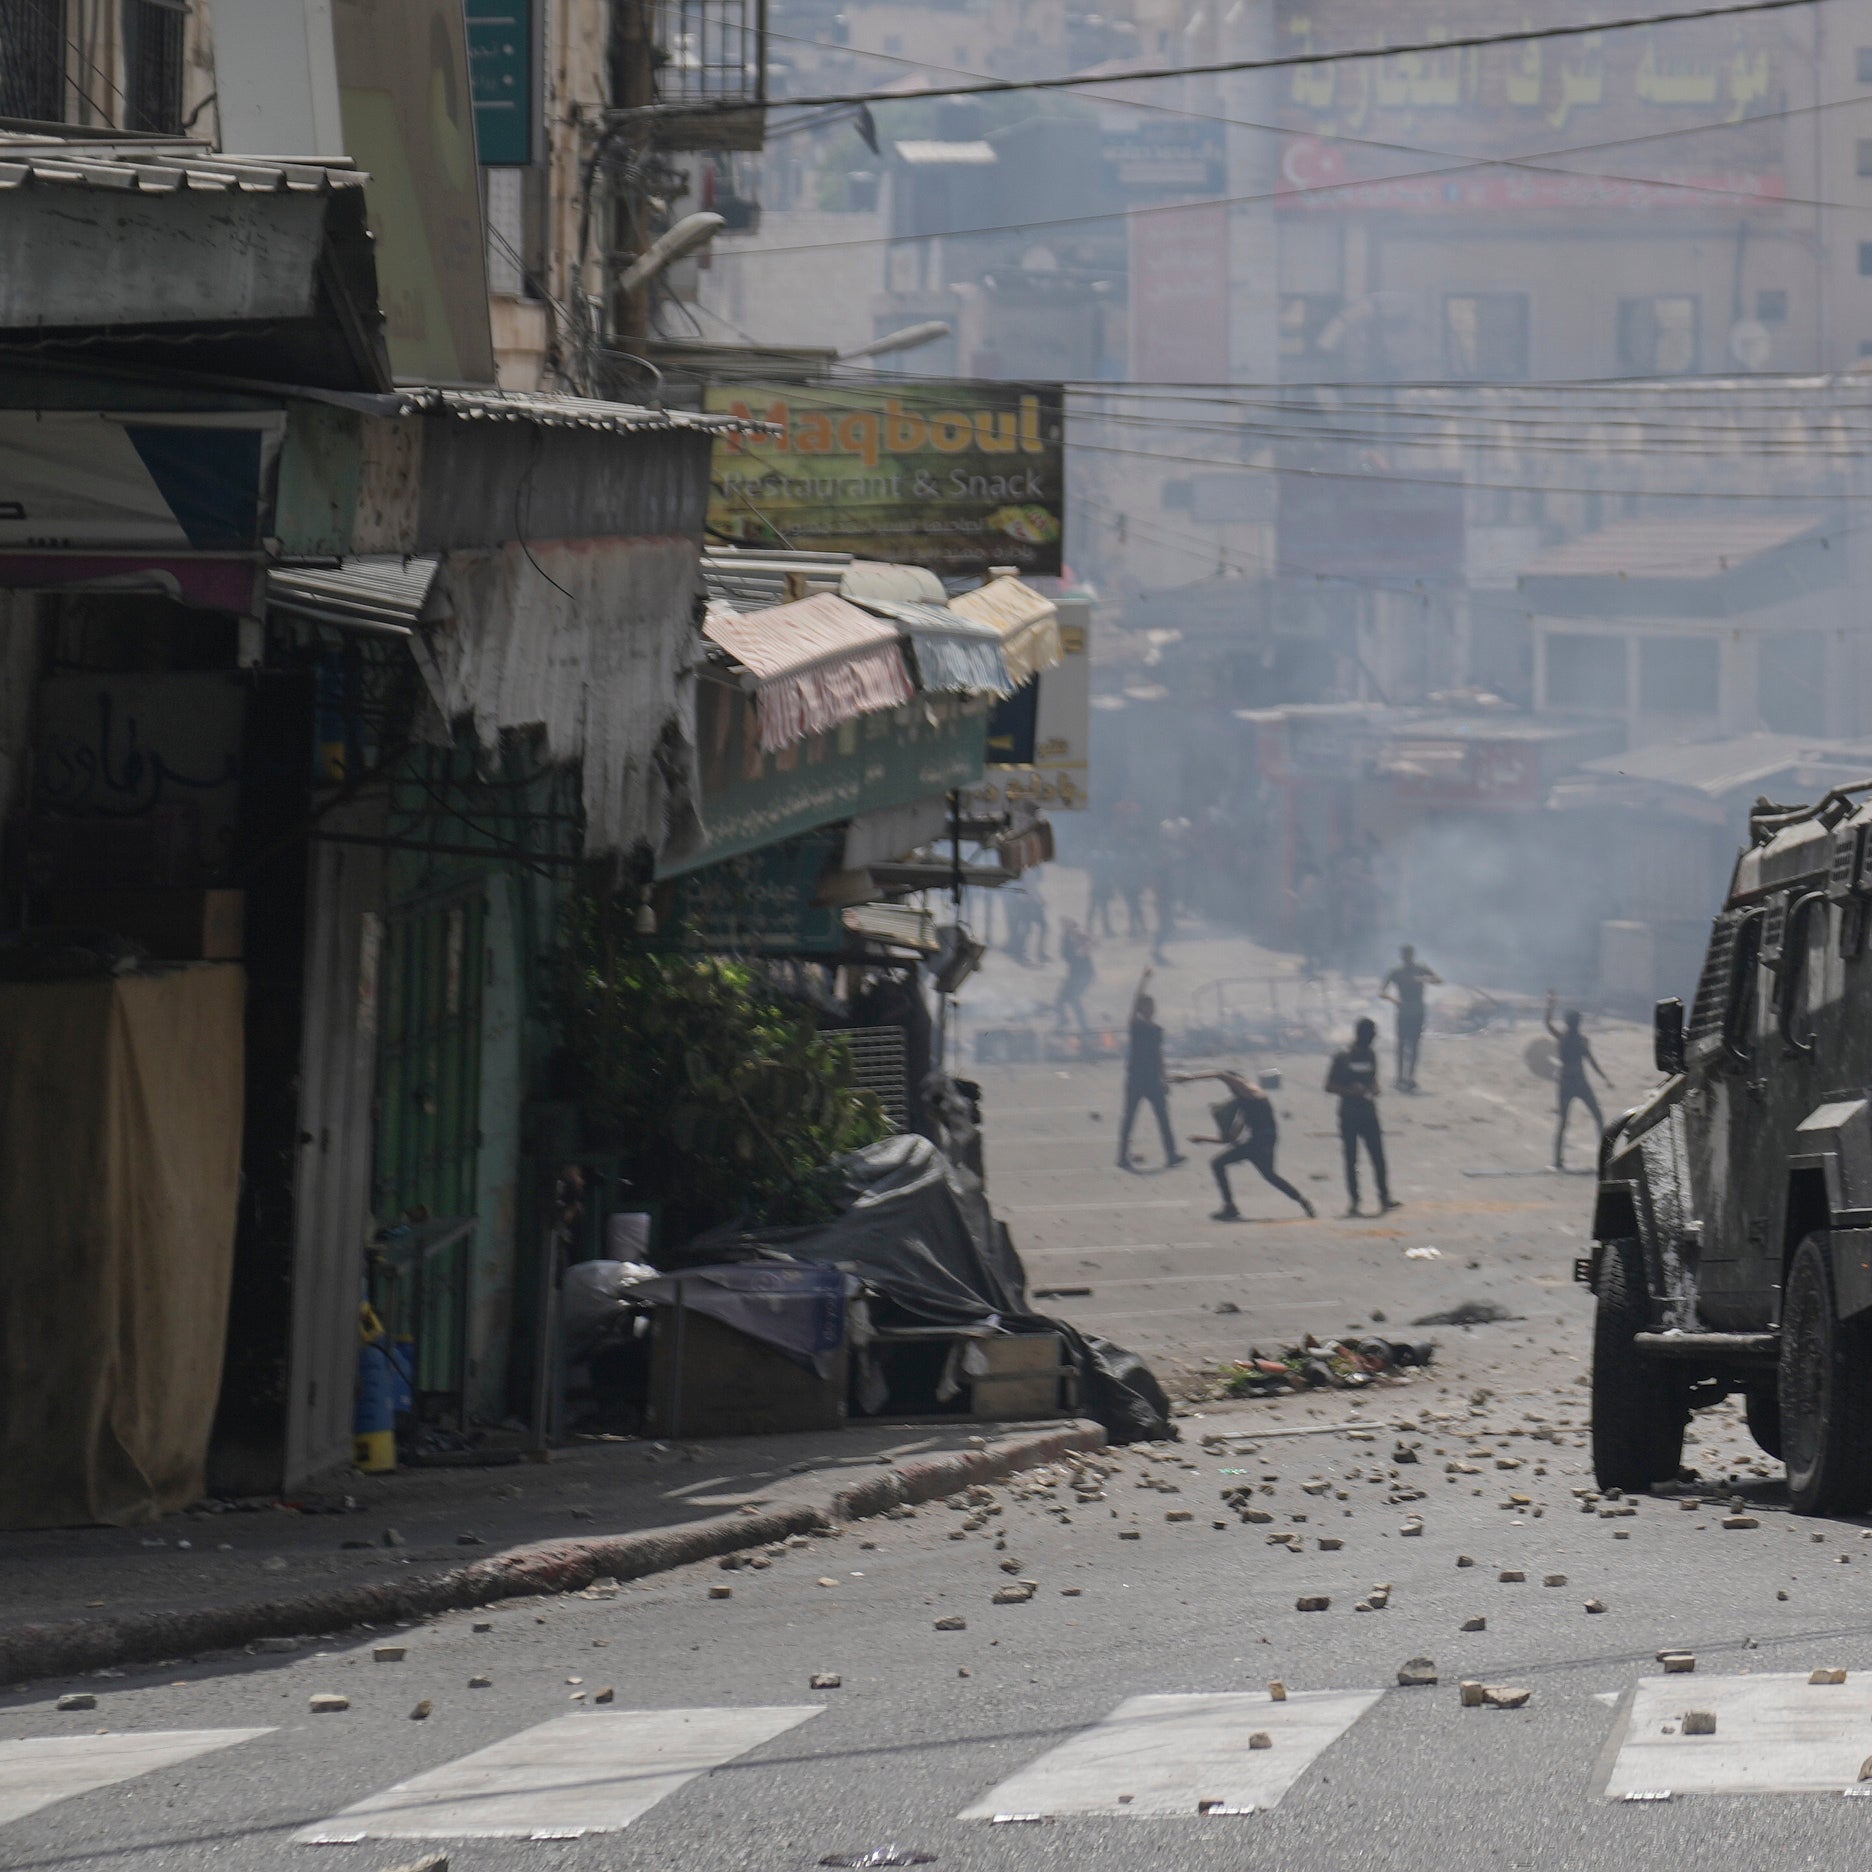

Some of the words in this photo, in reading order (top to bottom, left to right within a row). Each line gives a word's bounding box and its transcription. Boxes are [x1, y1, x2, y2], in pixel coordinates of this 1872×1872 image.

[726, 394, 1045, 468] Maqboul
[722, 474, 901, 499] Restaurant
[913, 469, 940, 498] &
[949, 468, 1045, 497] Snack
